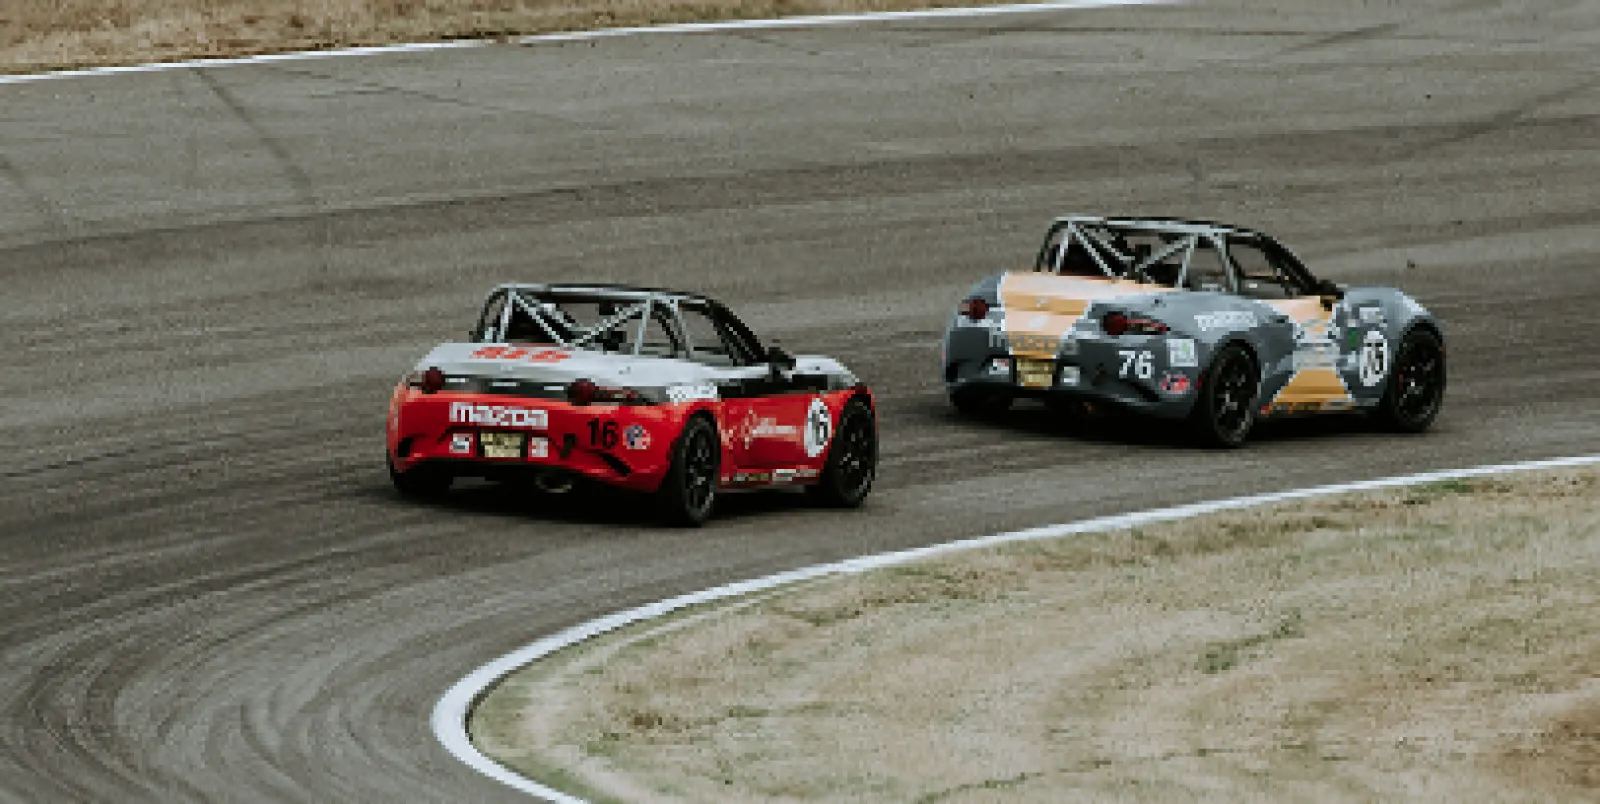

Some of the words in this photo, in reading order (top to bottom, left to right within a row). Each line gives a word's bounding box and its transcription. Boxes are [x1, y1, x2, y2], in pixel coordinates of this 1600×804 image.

[1119, 350, 1155, 379] 76
[587, 418, 618, 450] 16
[811, 406, 830, 446] 16
